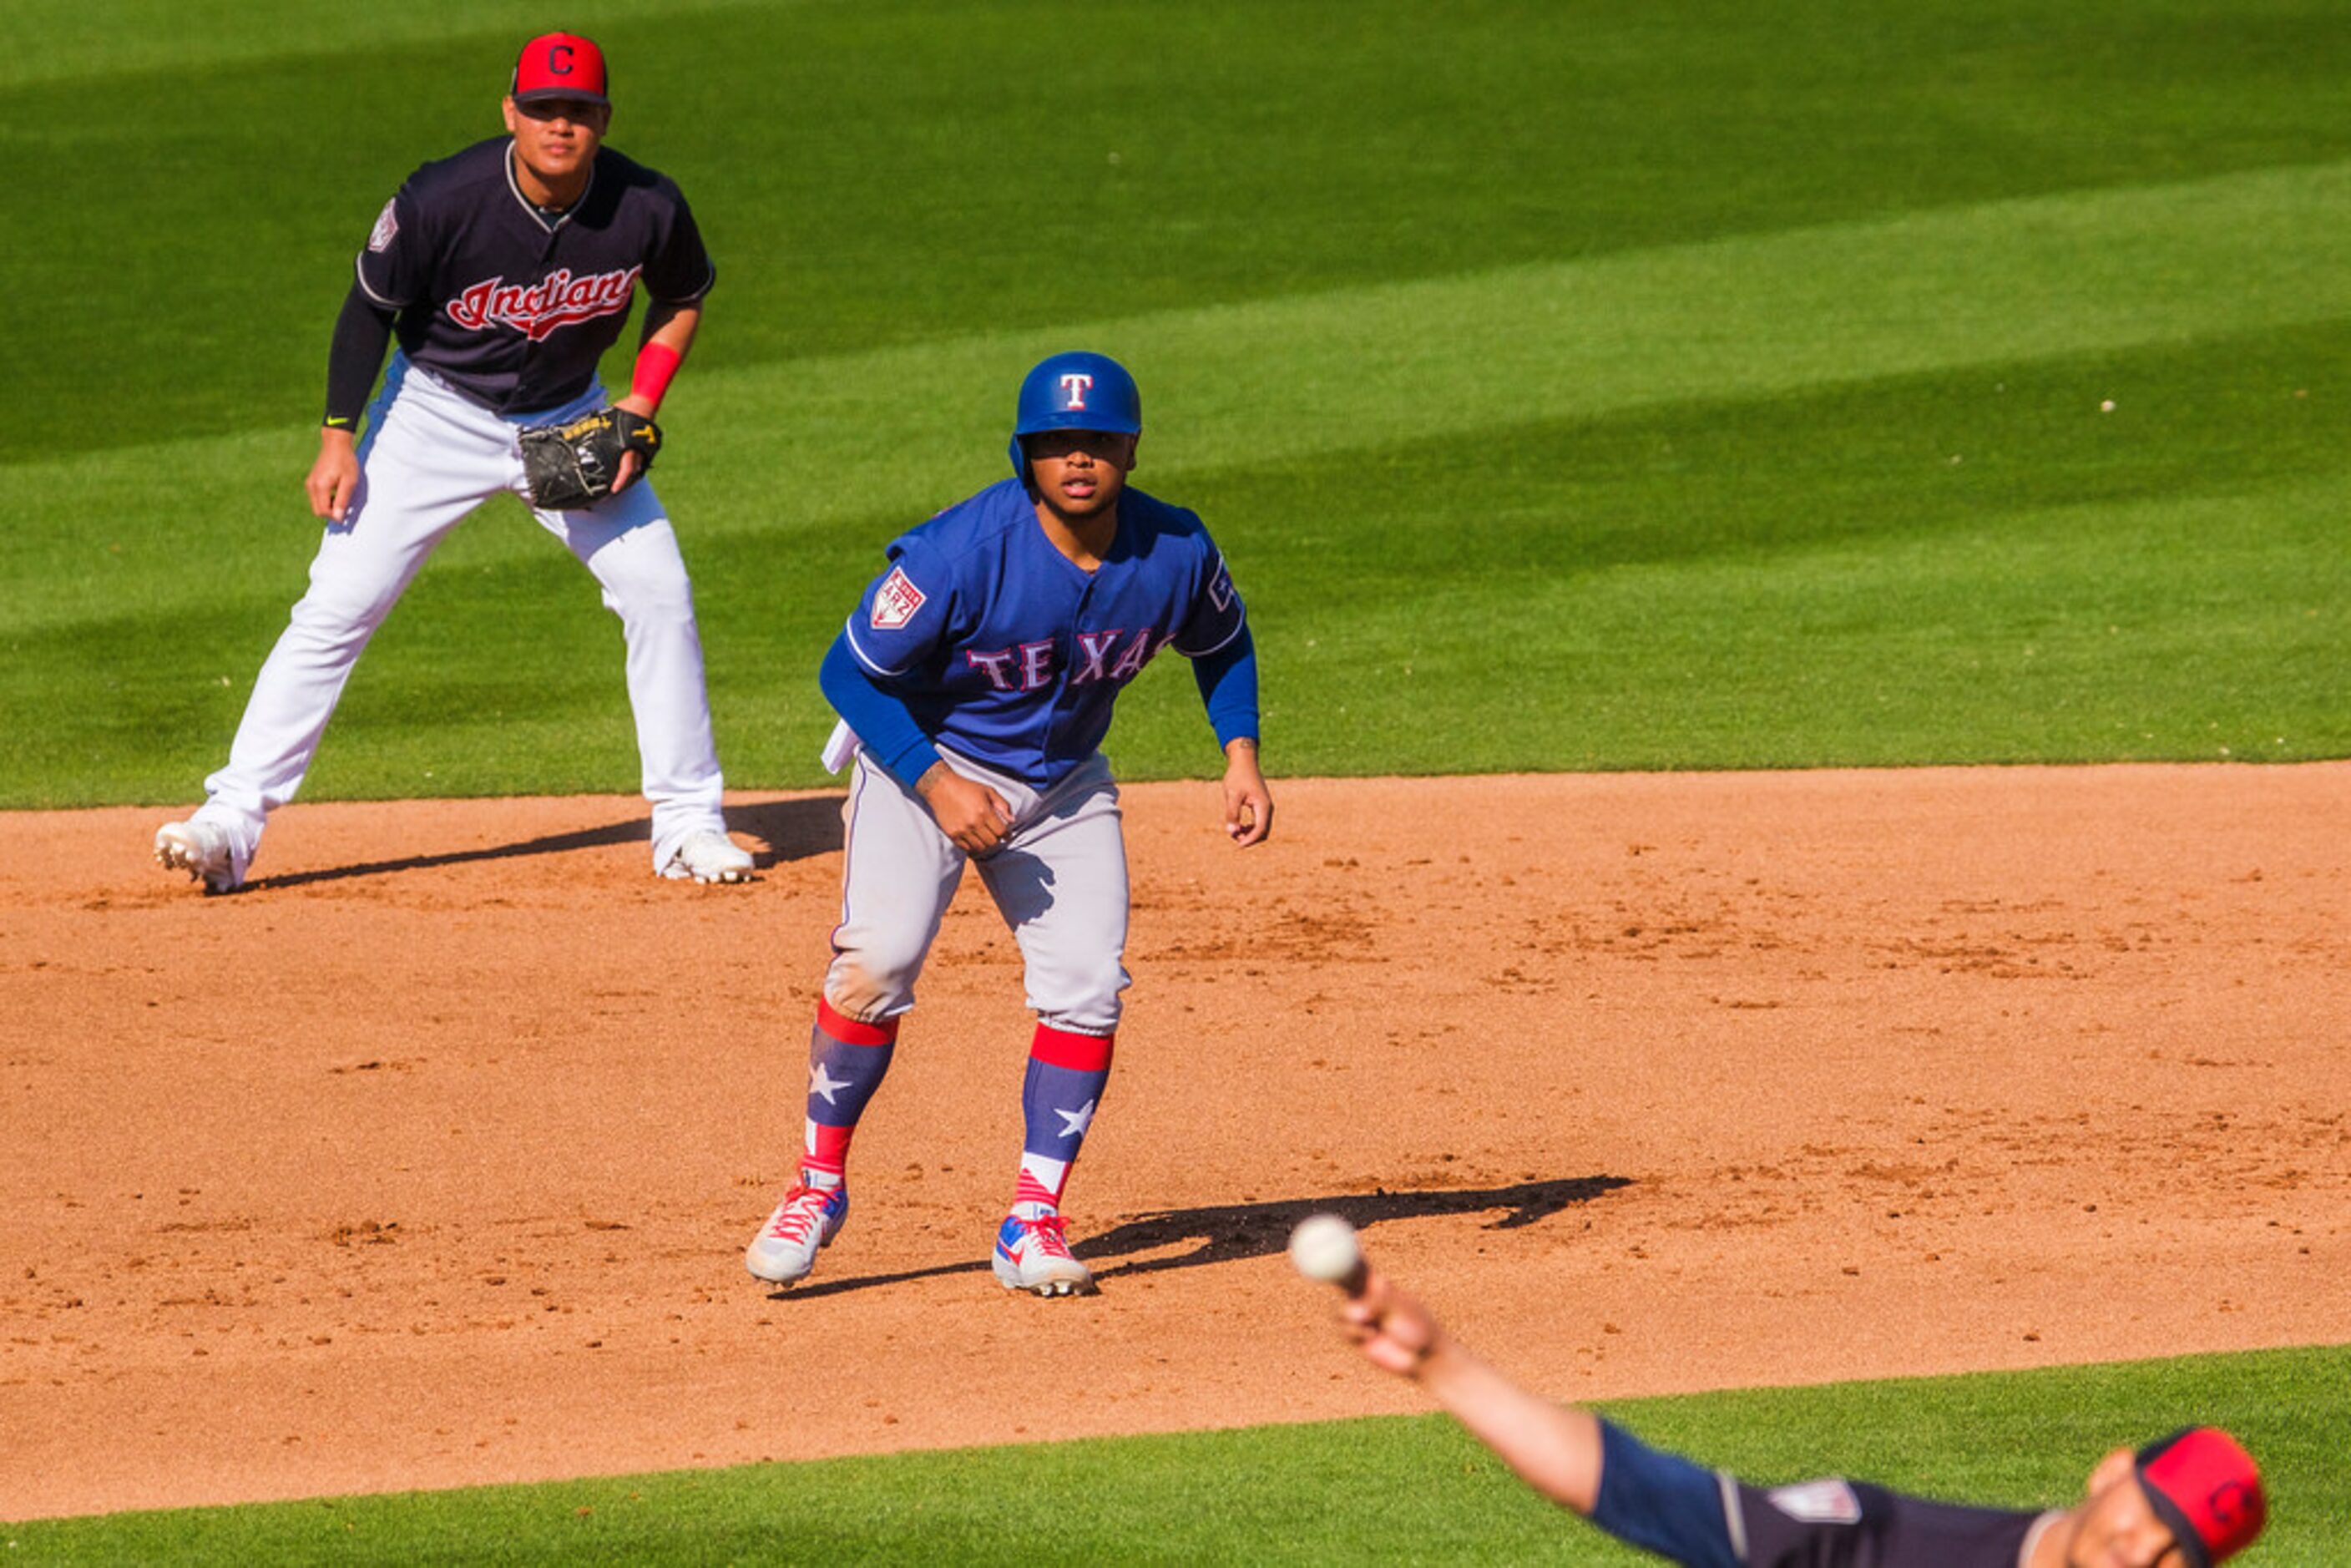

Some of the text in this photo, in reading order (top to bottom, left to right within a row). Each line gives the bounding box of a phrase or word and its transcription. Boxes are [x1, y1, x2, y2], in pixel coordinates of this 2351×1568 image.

[549, 45, 573, 74] C
[1059, 373, 1094, 410] T
[882, 585, 910, 616] ARZ
